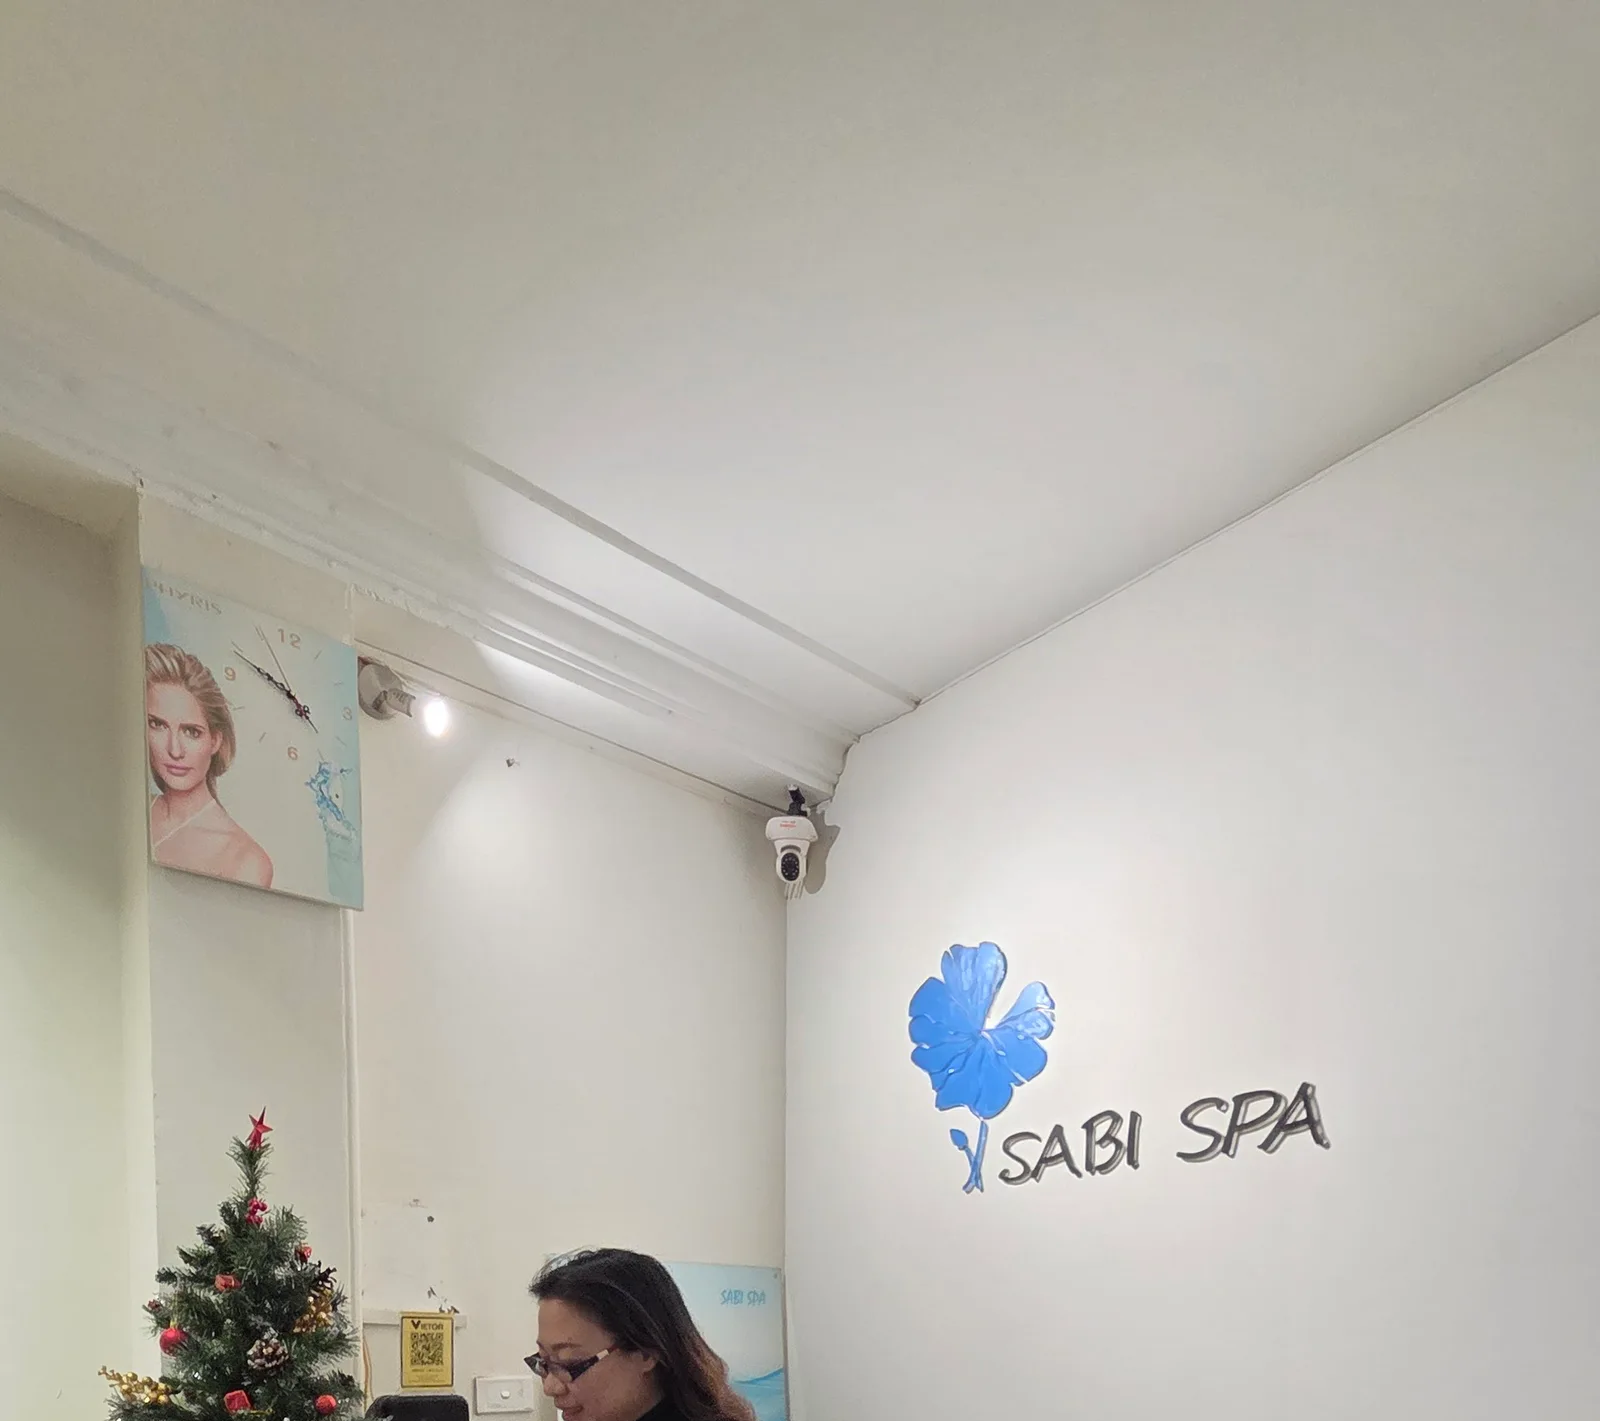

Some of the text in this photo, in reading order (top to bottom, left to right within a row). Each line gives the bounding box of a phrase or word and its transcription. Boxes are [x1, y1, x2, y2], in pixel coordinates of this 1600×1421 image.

[277, 627, 301, 650] 12
[224, 666, 237, 682] 9
[342, 705, 353, 721] 3
[287, 745, 299, 761] 6
[998, 1081, 1331, 1186] SABI SPA
[720, 1289, 767, 1306] SABI SPA
